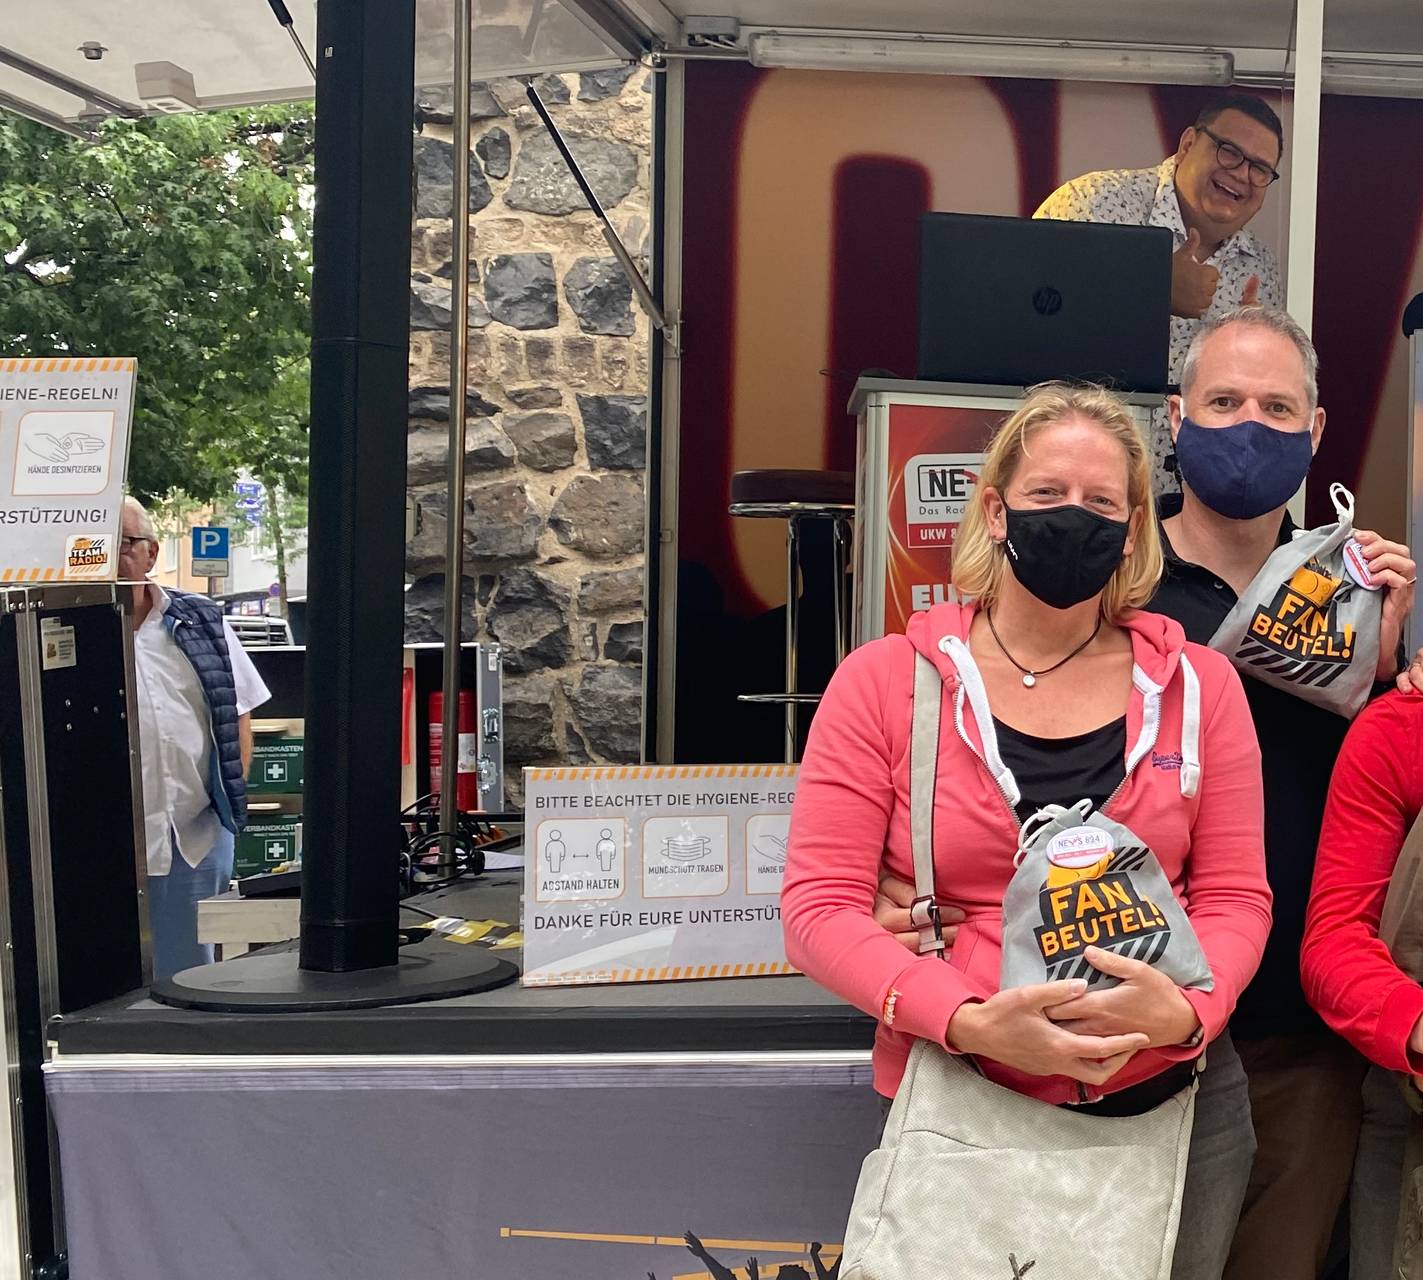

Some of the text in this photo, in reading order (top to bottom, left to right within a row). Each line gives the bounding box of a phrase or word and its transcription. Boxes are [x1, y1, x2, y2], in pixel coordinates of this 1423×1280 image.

[27, 464, 102, 474] HÄNDE DESINFIZIEREN
[919, 505, 939, 515] Das
[920, 528, 947, 540] UKW
[200, 531, 221, 555] P
[72, 548, 101, 557] TEAM
[69, 553, 107, 566] RADIO!
[1277, 593, 1329, 637] FAN
[1252, 612, 1353, 659] BEUTEL!
[535, 796, 579, 809] BITTE
[583, 794, 663, 808] BEACHTET
[667, 793, 691, 806] DIE
[696, 864, 724, 873] TRAGEN
[757, 865, 778, 874] HÄNDE
[586, 878, 620, 890] HALTEN
[1050, 881, 1133, 925] FAN
[534, 914, 594, 929] DANKE
[599, 909, 633, 927] FÜR
[638, 911, 684, 926] EURE
[1041, 896, 1165, 957] BEUTEL!
